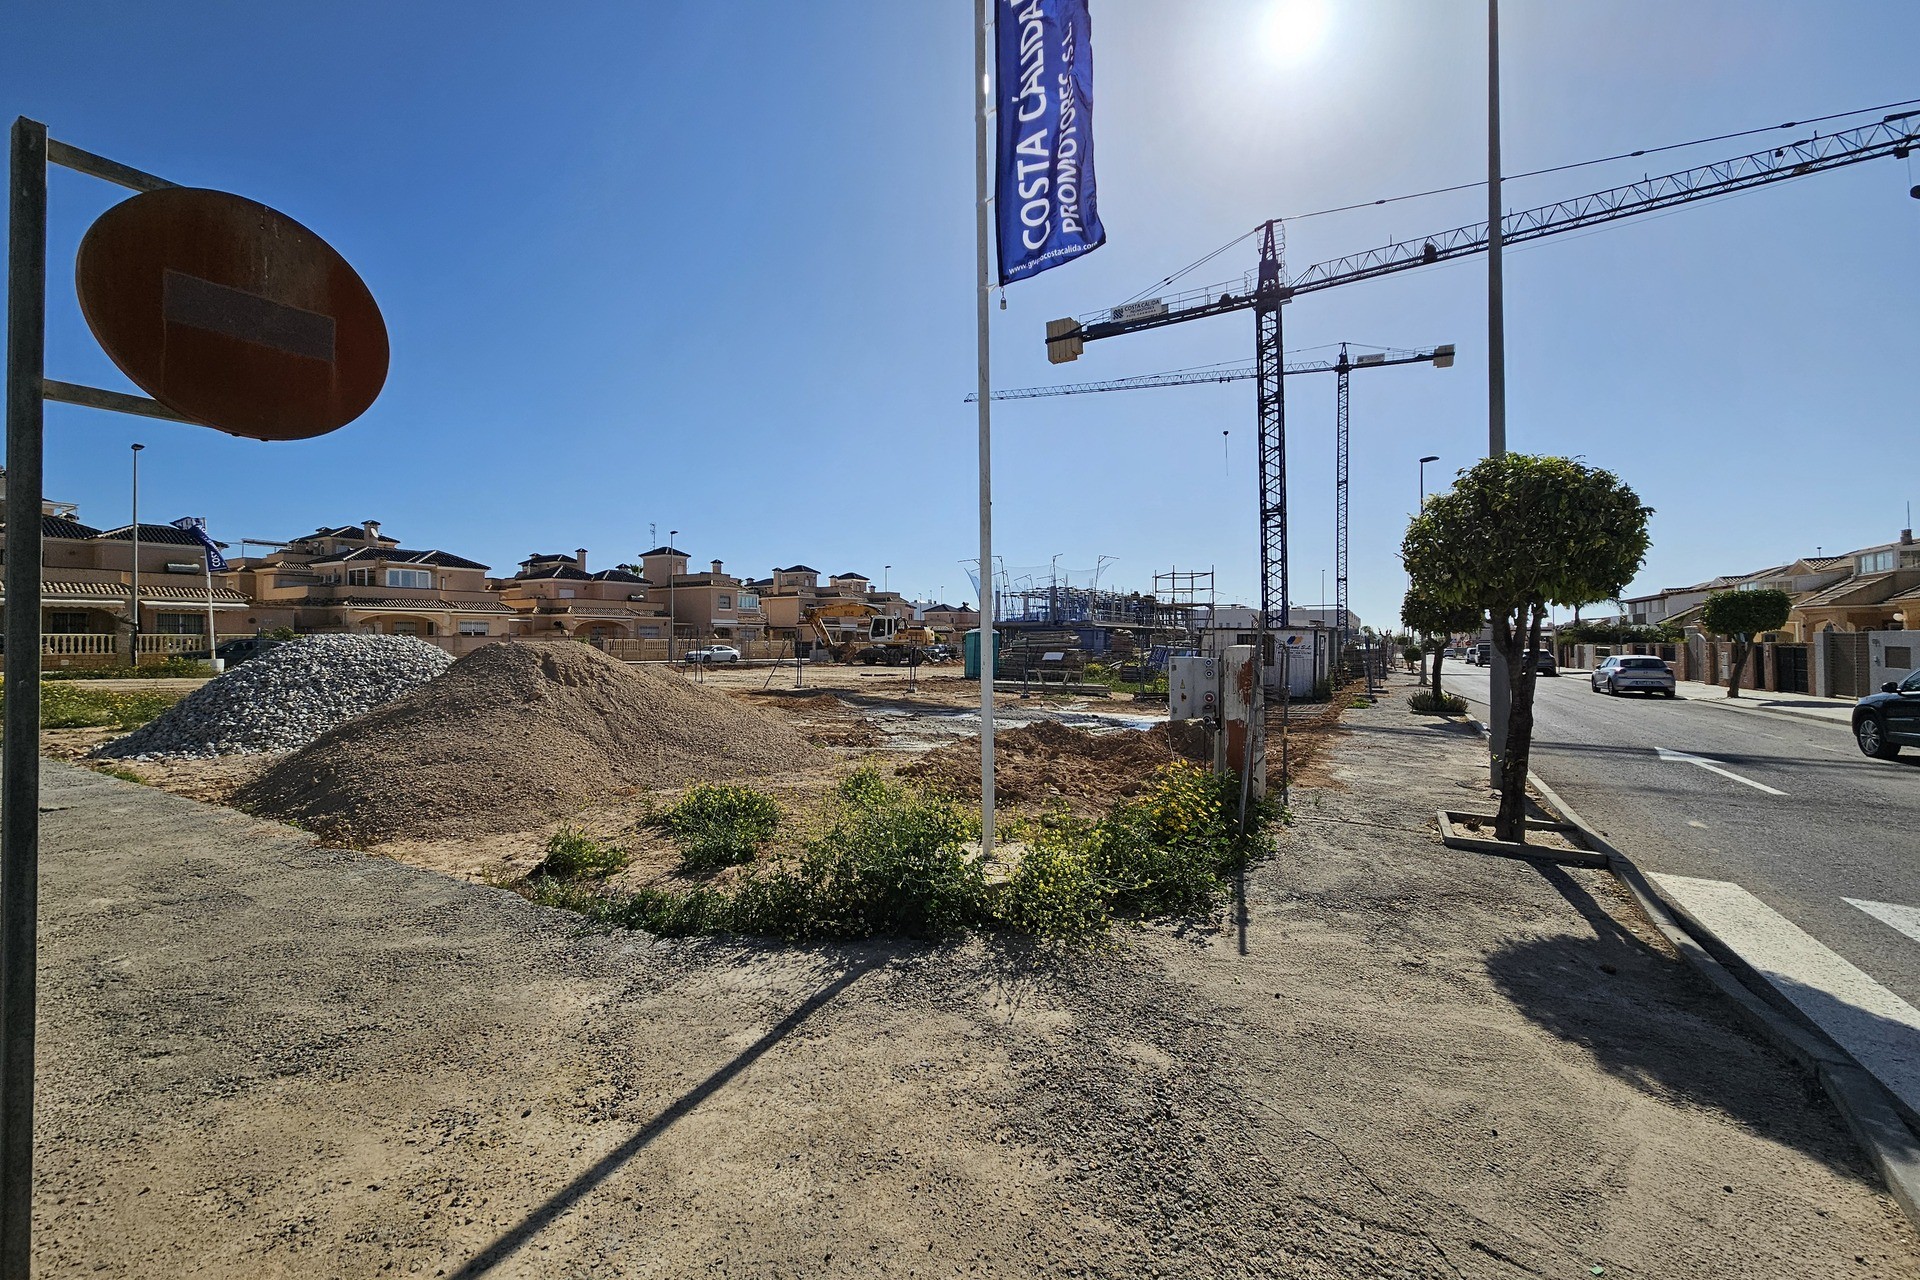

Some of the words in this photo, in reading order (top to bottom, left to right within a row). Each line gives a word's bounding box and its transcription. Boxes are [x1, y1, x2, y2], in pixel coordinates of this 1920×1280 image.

[1011, 0, 1047, 122] CÁLIDA
[1016, 128, 1050, 250] COSTA
[1056, 65, 1083, 233] PROMOTORES
